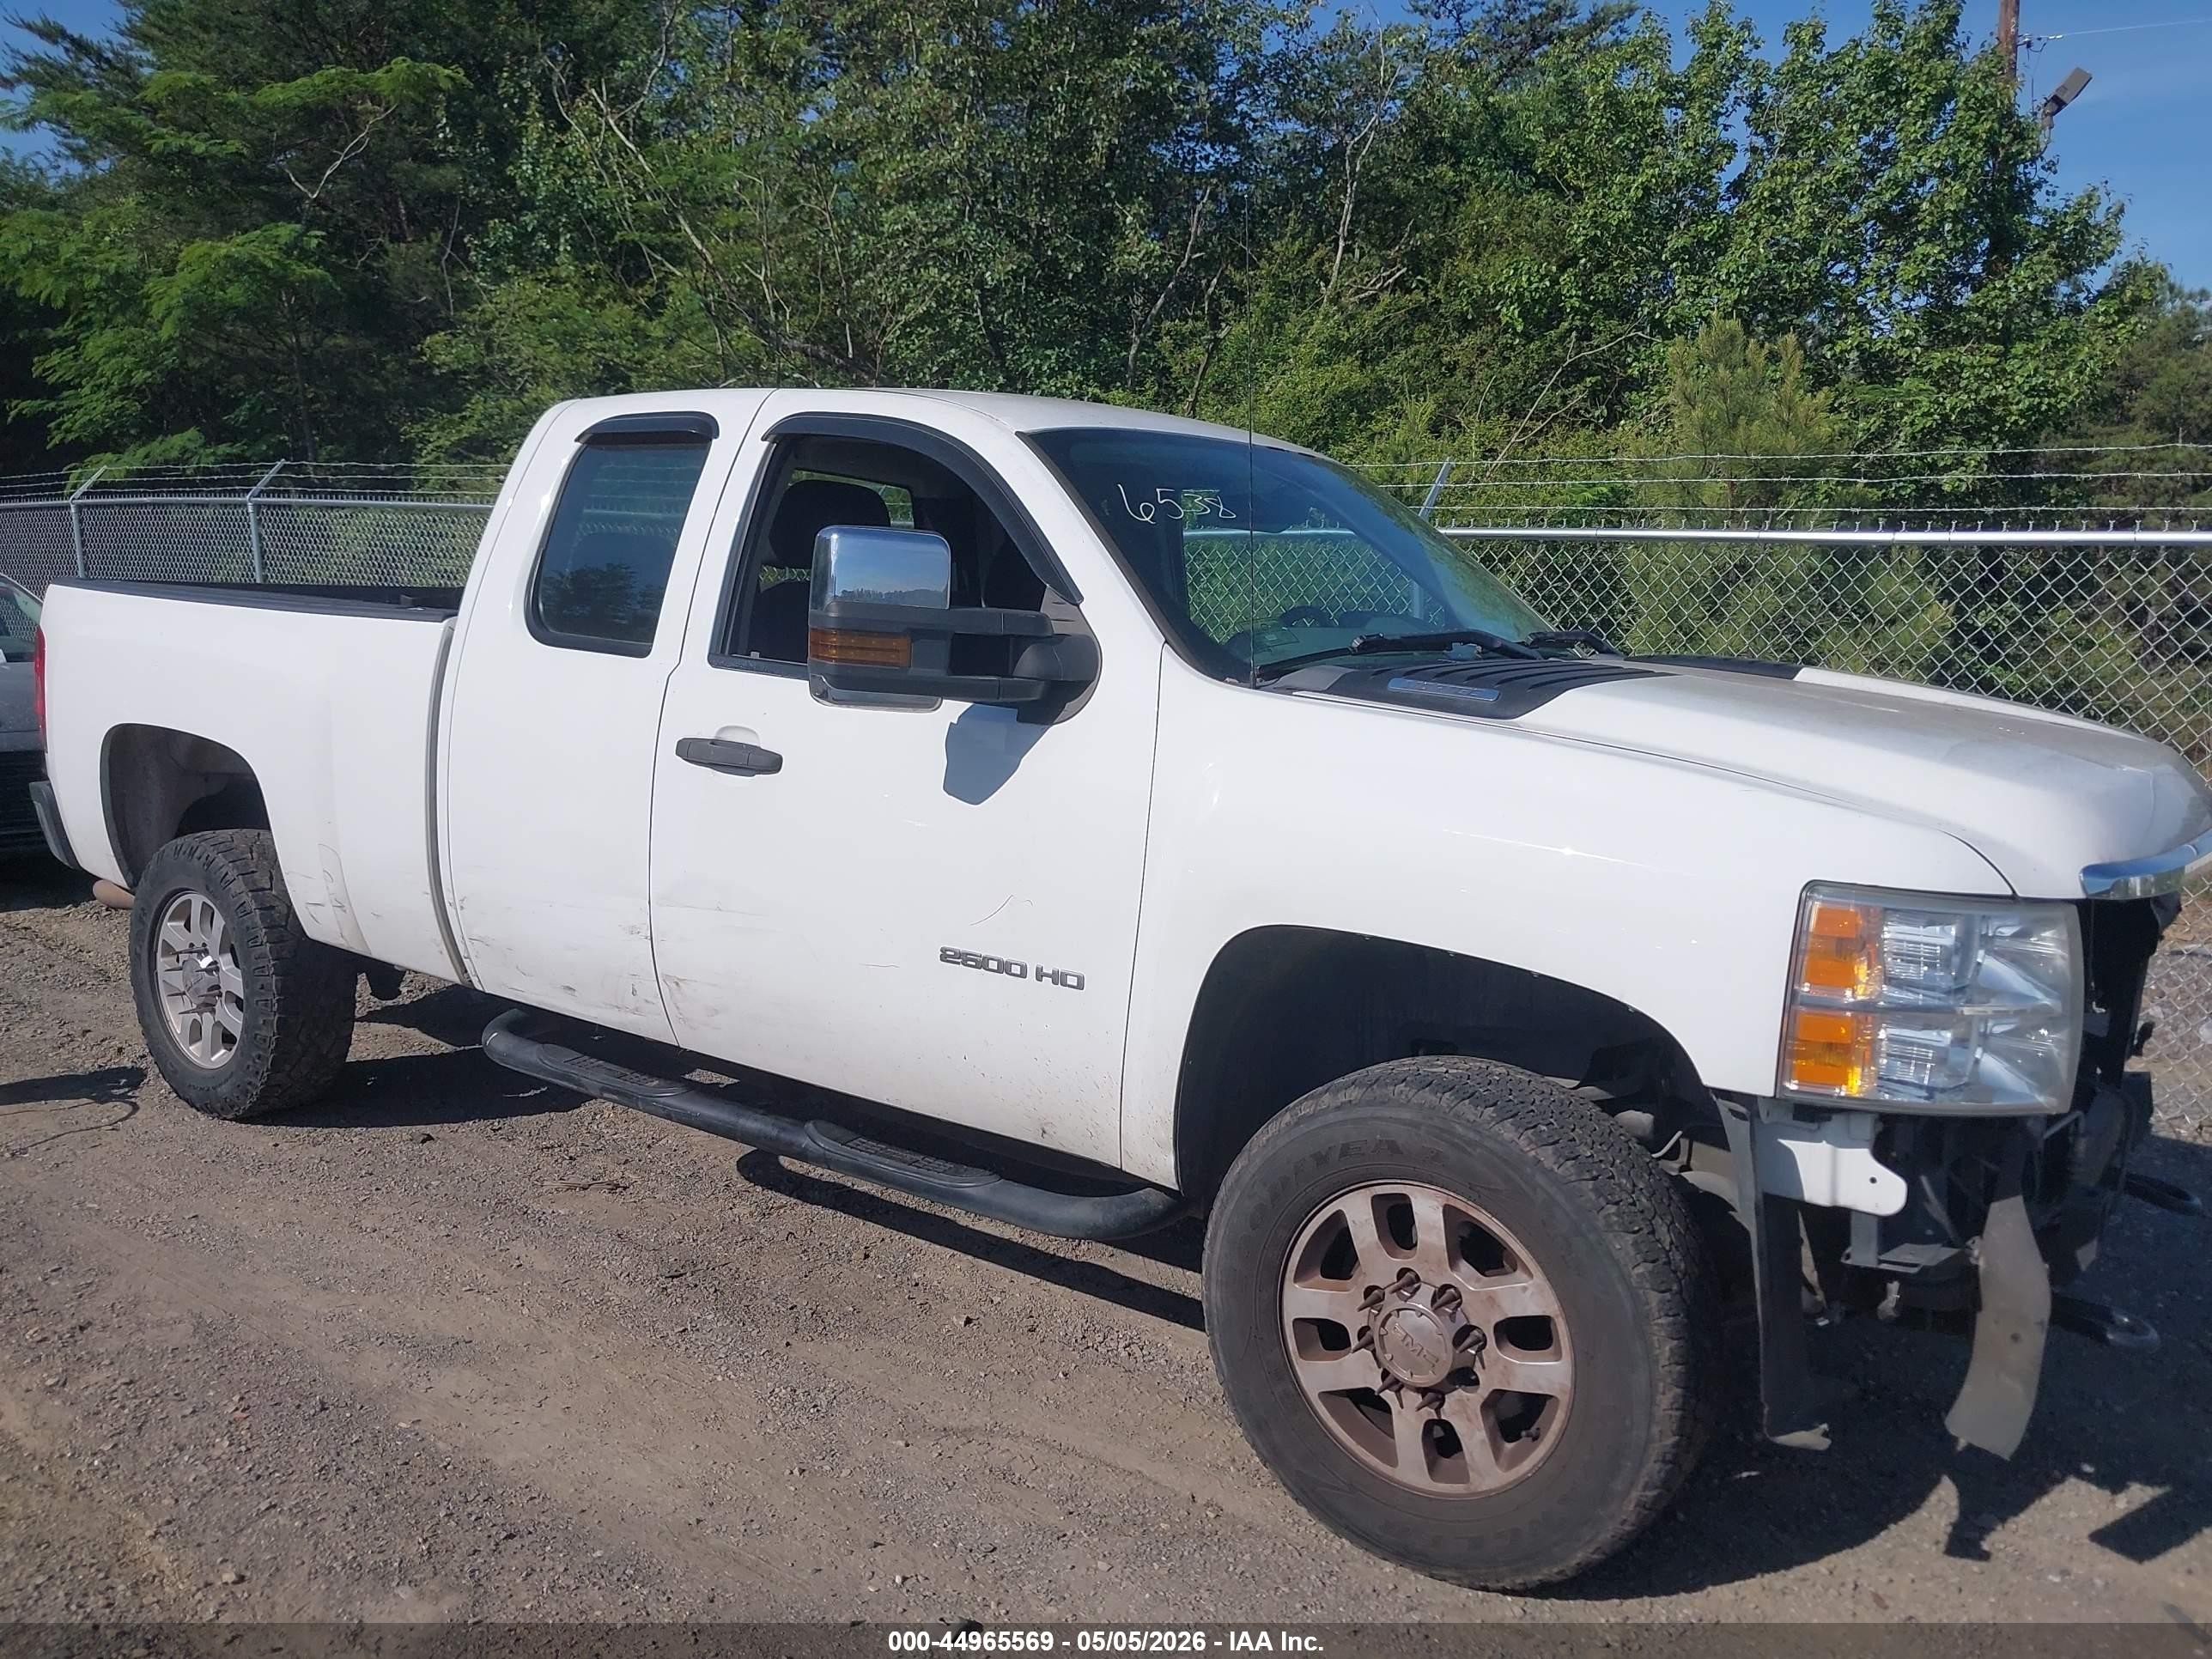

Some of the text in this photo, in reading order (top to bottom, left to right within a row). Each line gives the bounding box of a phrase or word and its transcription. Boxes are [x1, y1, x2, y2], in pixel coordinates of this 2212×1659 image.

[1117, 483, 1237, 525] 6538
[939, 945, 1085, 991] 2500 HD
